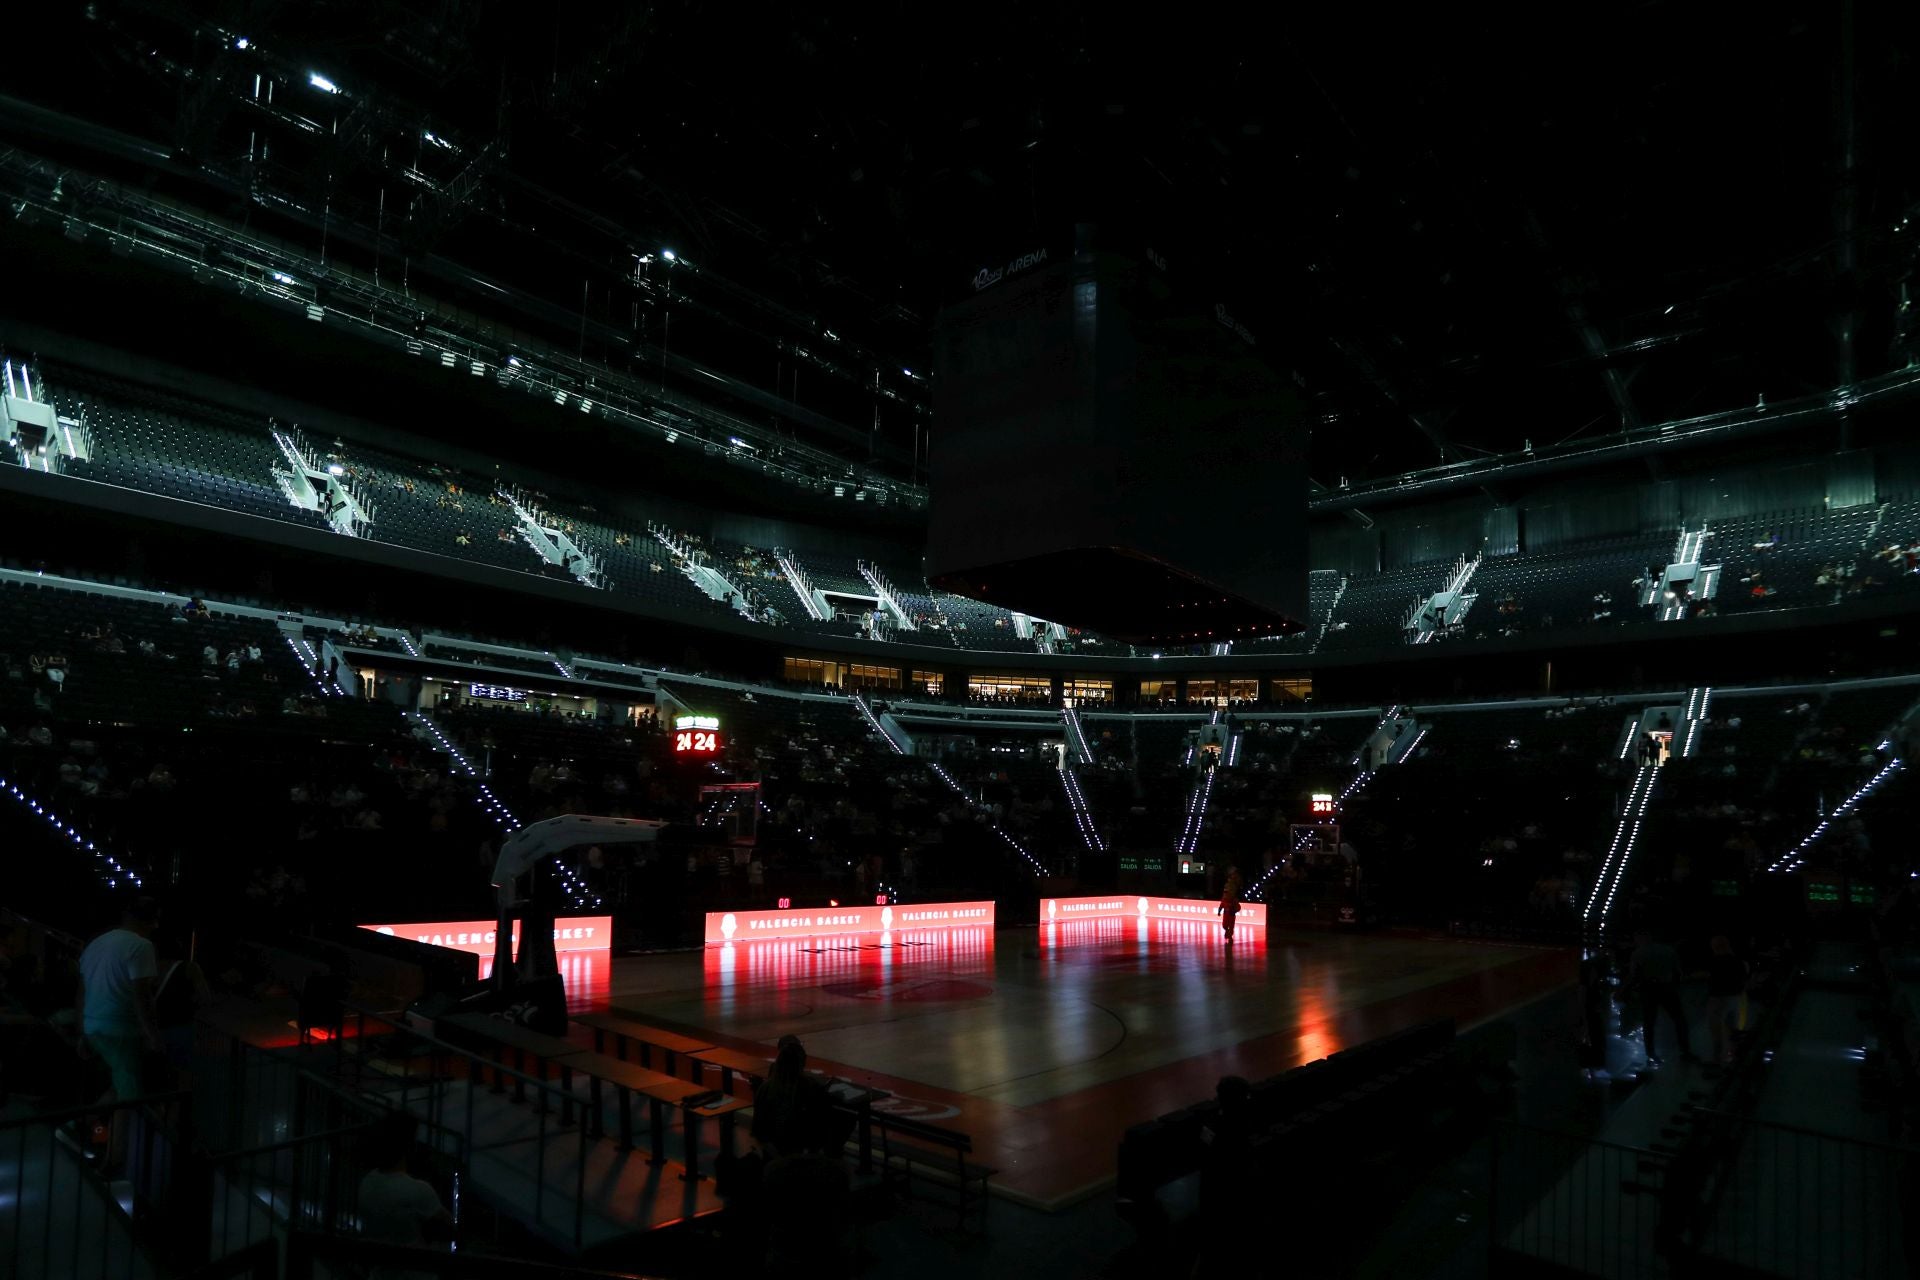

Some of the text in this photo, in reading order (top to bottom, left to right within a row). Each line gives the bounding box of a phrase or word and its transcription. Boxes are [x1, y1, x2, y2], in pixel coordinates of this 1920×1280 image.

[1007, 248, 1047, 275] ARENA
[677, 733, 691, 751] 24
[694, 733, 716, 751] 24
[1062, 903, 1096, 912] VALENCIA
[1157, 903, 1208, 914] VALENCIA
[750, 915, 861, 930] VALENCIA BASKET
[902, 909, 987, 922] VALENCIA BASKET
